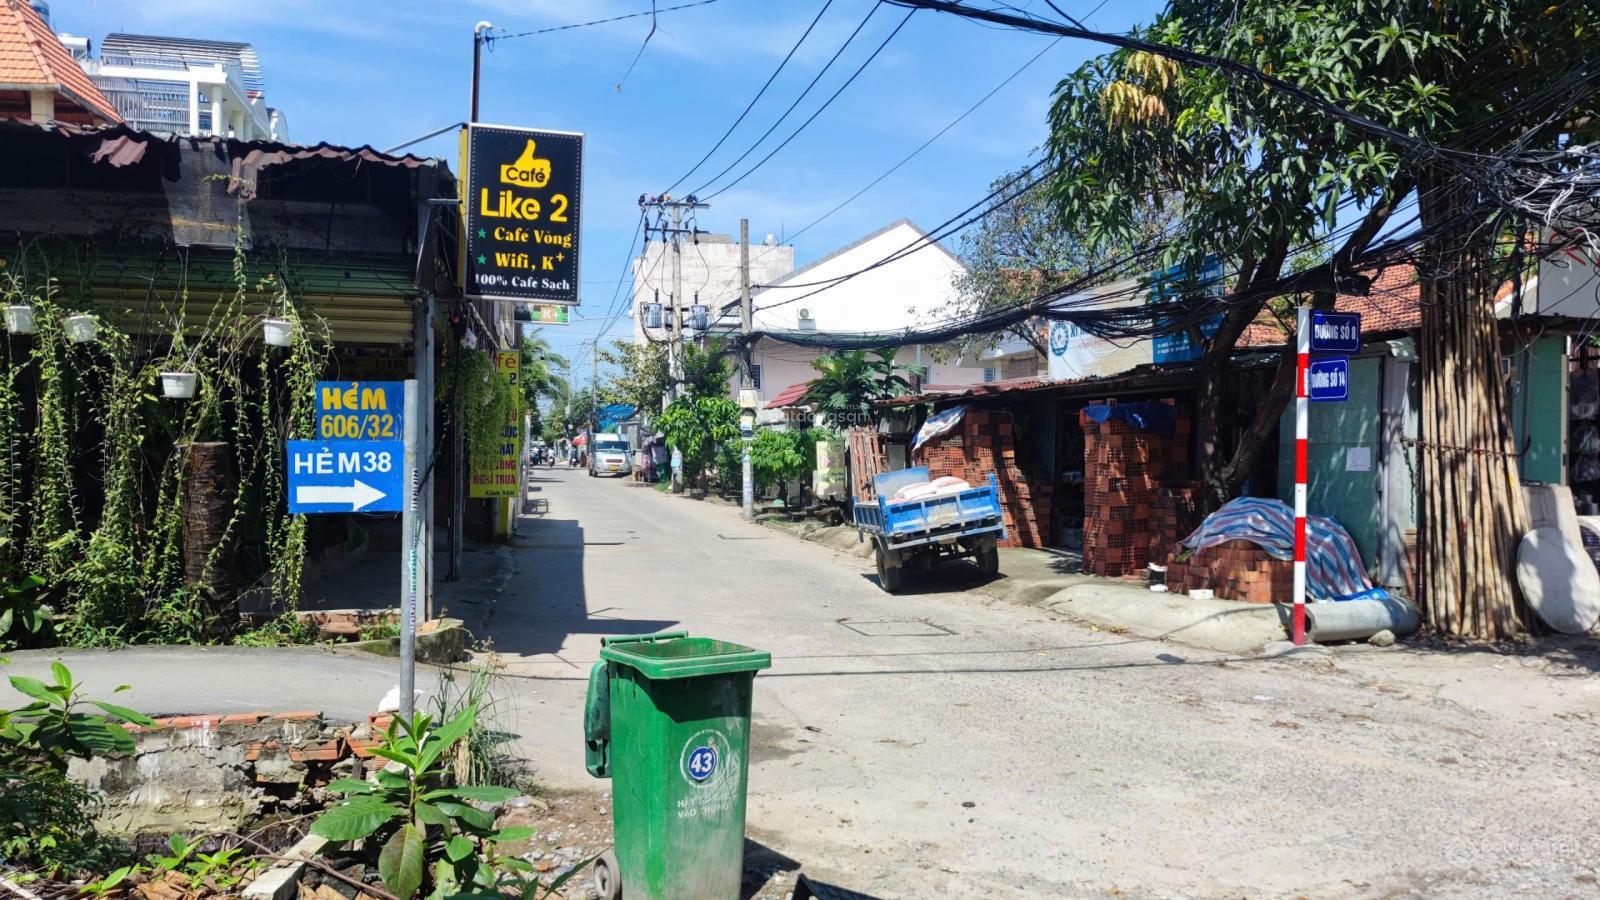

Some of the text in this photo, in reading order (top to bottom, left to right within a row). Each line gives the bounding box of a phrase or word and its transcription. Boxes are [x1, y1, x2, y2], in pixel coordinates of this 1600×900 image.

[505, 165, 546, 183] Café
[480, 187, 569, 223] Like 2
[474, 272, 508, 287] 100%
[541, 277, 570, 291] Sạch
[1314, 320, 1357, 341] ĐƯỜNG SỐ 8
[509, 372, 517, 385] 2
[1329, 367, 1338, 388] SỐ
[1338, 371, 1346, 387] 14
[321, 381, 387, 411] HẺM
[320, 413, 395, 440] 606/32
[690, 752, 713, 774] 43
